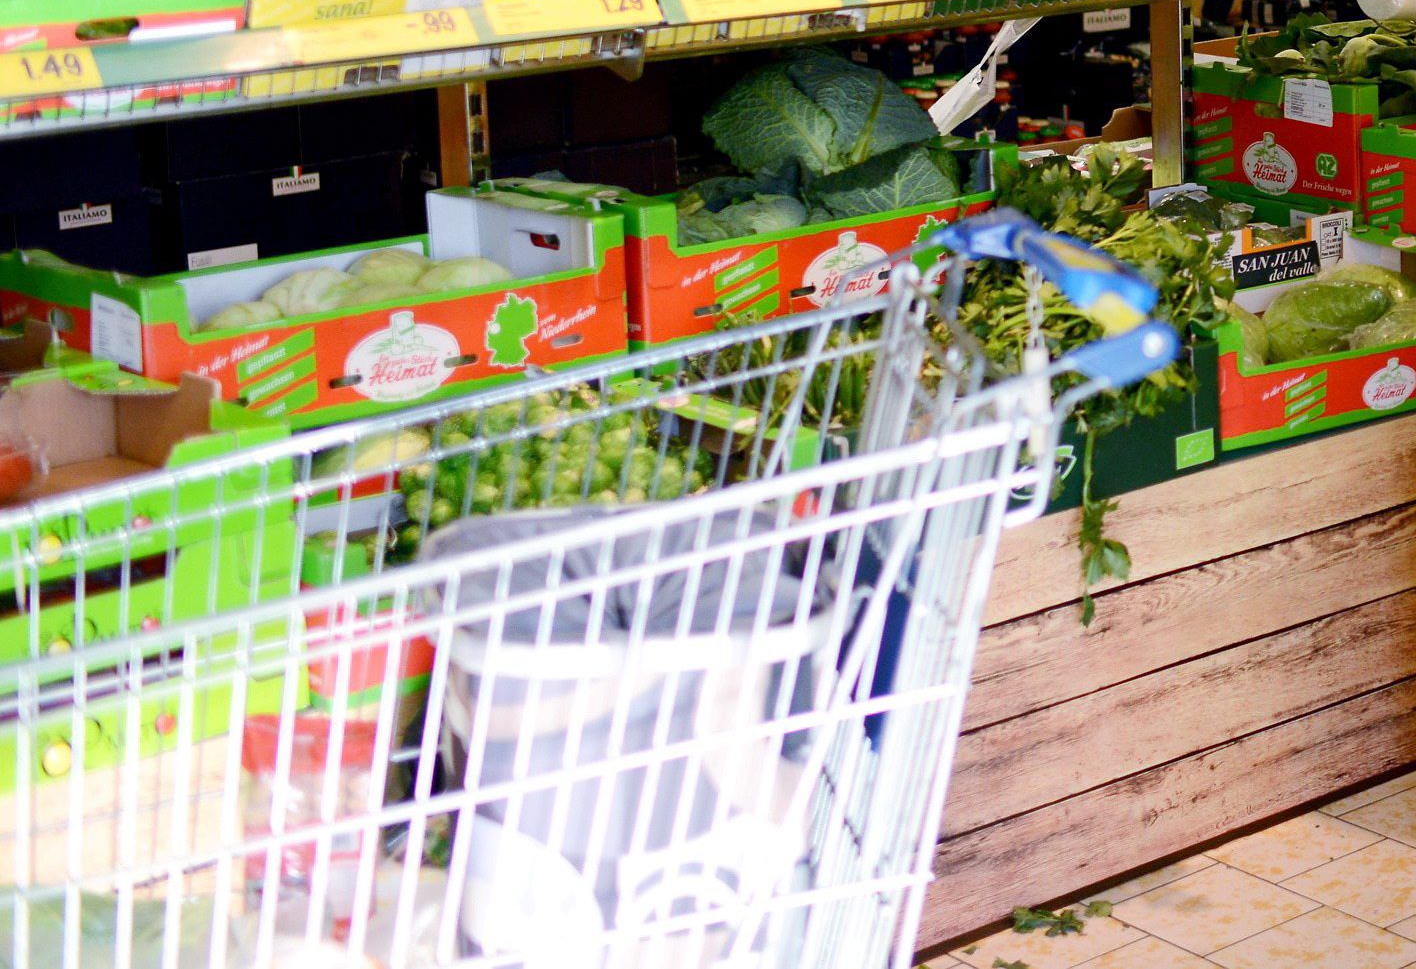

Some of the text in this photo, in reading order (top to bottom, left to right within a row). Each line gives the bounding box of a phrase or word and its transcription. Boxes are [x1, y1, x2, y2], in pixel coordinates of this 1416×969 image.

[314, 0, 374, 20] sana!
[21, 52, 84, 80] 1.49
[1253, 162, 1287, 183] Heimat
[276, 177, 316, 189] ITALIAMO
[1303, 180, 1352, 196] Der Frische wegen
[63, 208, 108, 222] ITALIAMO
[1238, 255, 1270, 274] SAN
[1271, 247, 1311, 268] JUAN
[1269, 262, 1316, 282] del valle
[539, 304, 597, 342] Niederrhein
[369, 357, 438, 387] Heimat
[1373, 387, 1406, 401] Heimat
